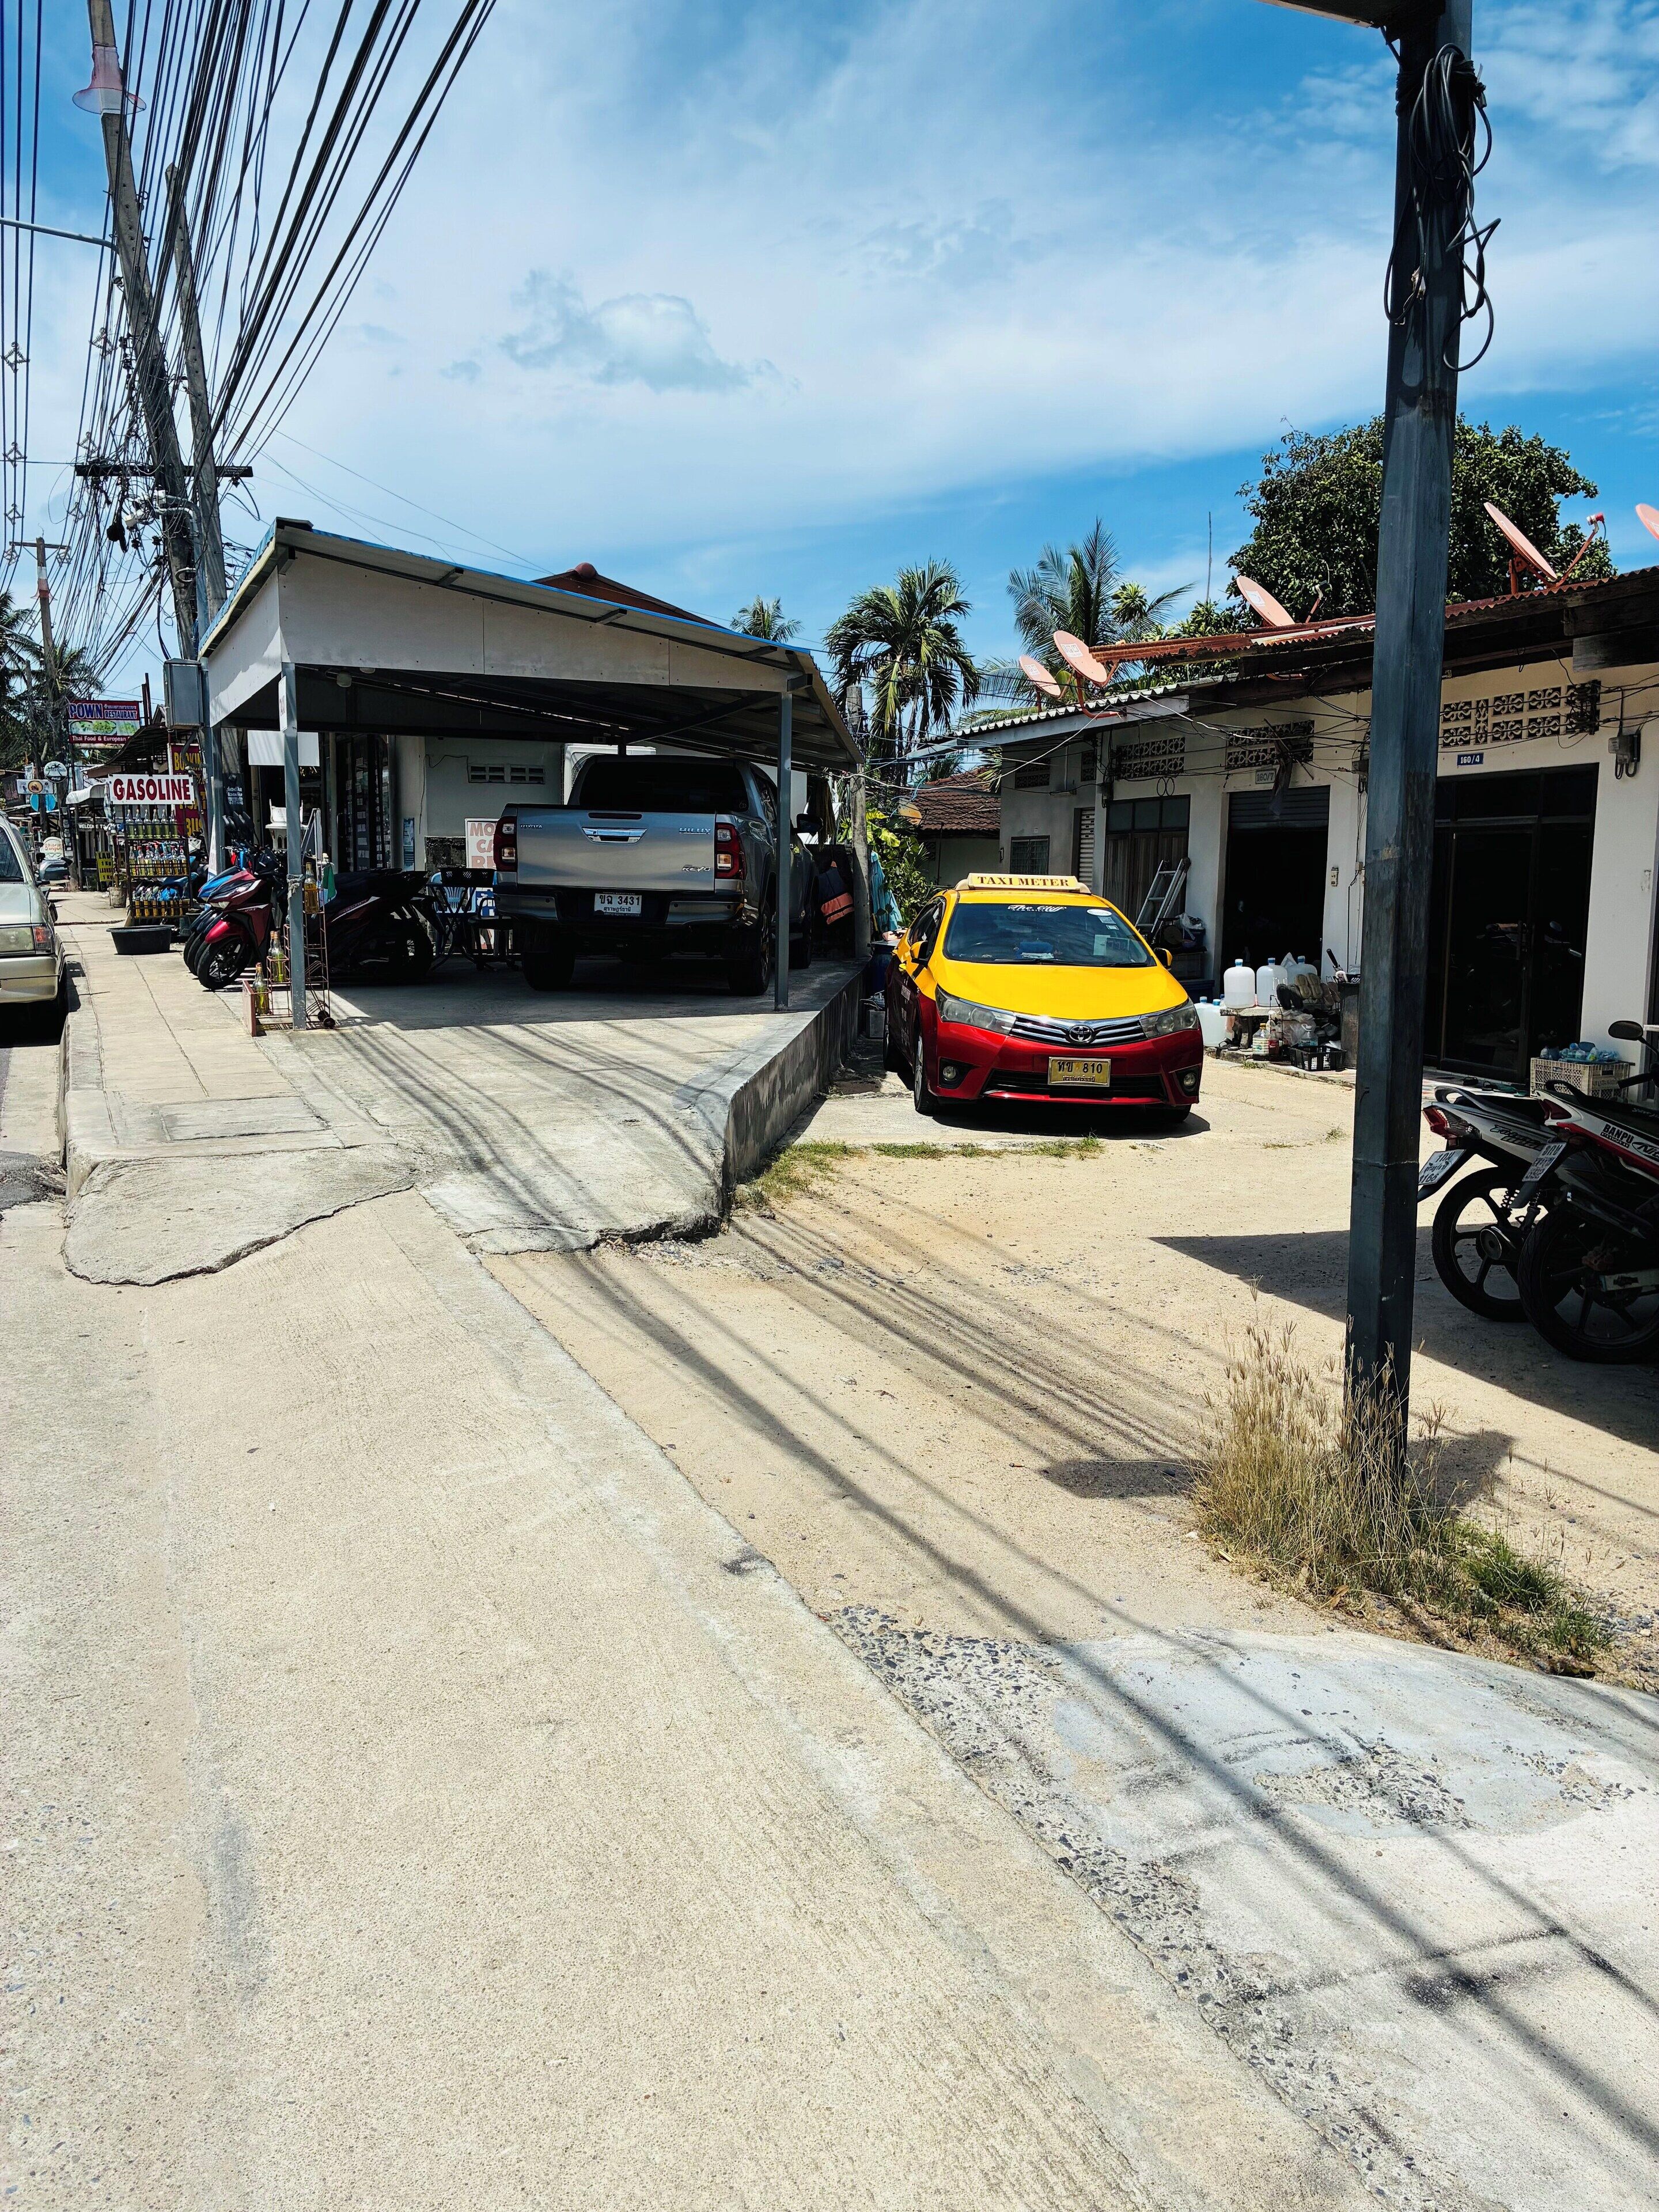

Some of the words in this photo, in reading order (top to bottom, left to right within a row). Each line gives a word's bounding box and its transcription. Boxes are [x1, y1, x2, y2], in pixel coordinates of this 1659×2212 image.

[104, 710, 138, 719] RESTAURANT
[1460, 755, 1480, 764] 160/4
[1257, 772, 1274, 782] 160/7
[113, 778, 191, 801] GASOLINE
[978, 876, 1013, 885] TAXI
[1018, 877, 1069, 887] METER
[618, 896, 640, 906] 3431
[1082, 1062, 1103, 1073] 810
[1602, 1124, 1635, 1144] BANPU
